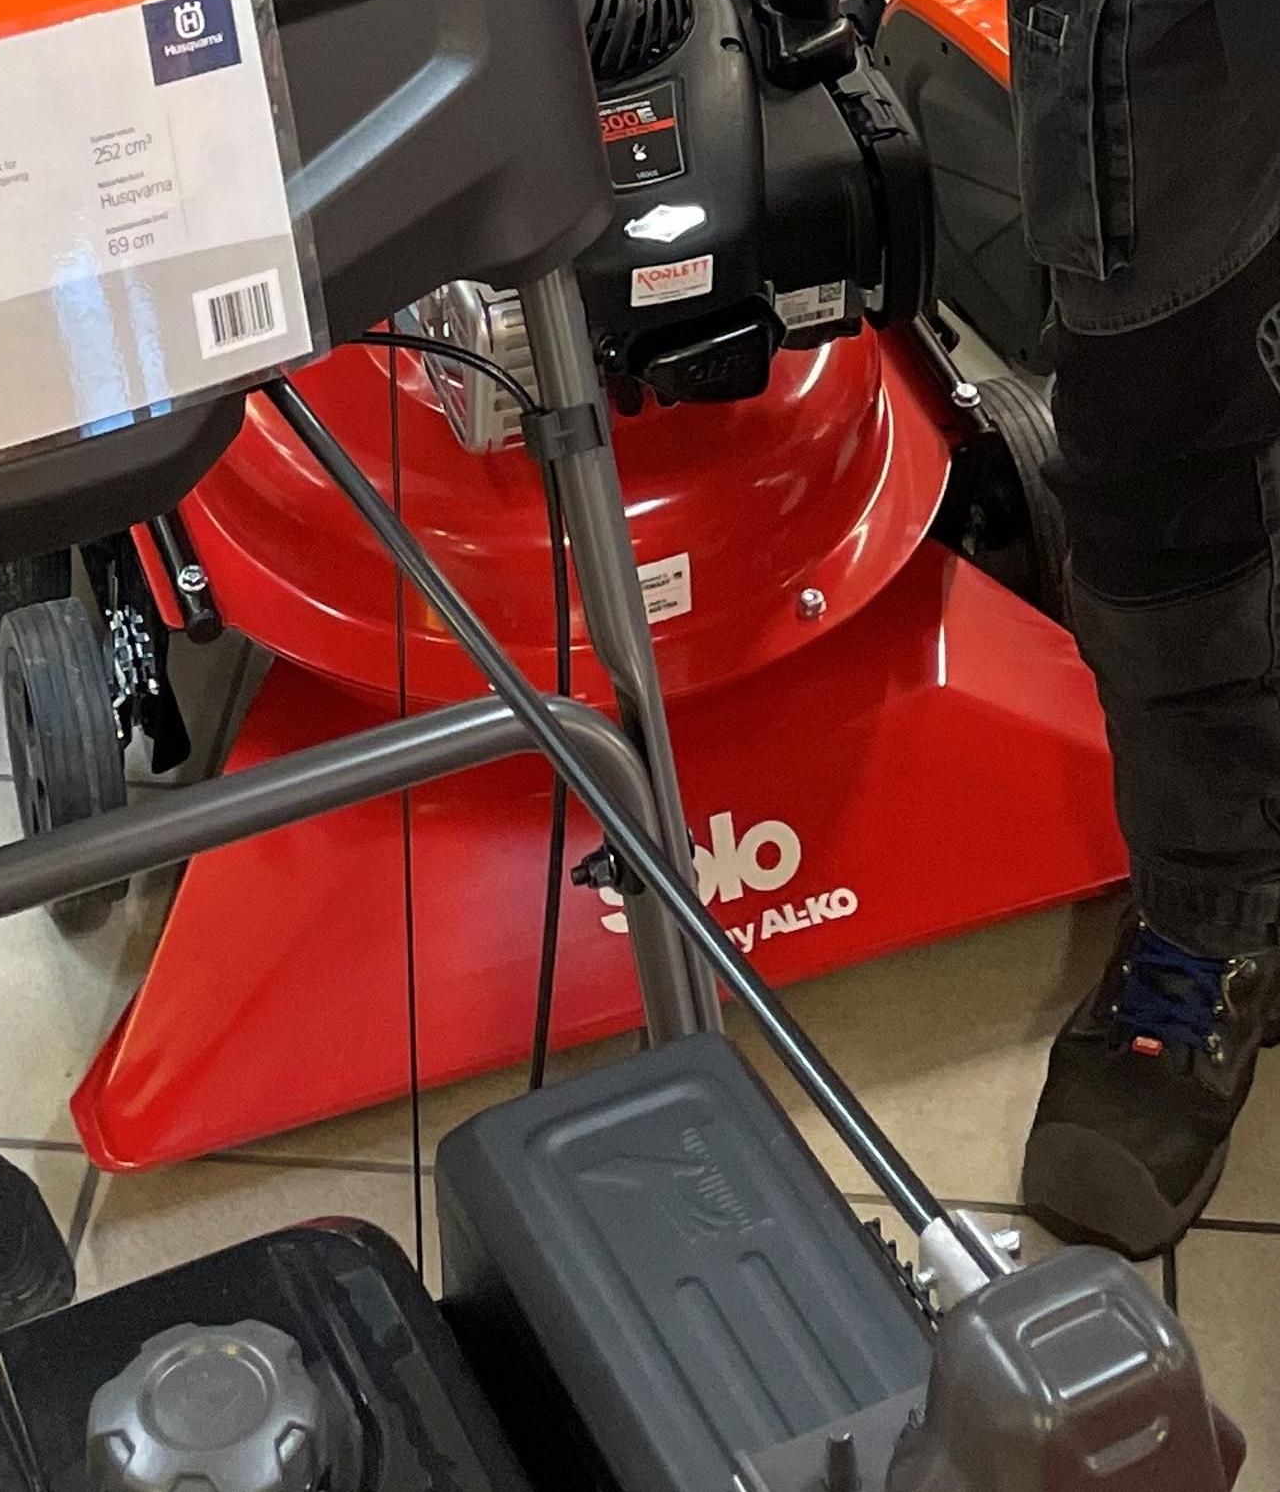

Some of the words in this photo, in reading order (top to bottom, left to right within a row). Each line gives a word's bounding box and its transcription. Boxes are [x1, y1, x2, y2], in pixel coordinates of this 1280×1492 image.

[164, 32, 223, 57] Husqvarna
[92, 142, 121, 166] 252
[100, 179, 173, 210] Husqvarna
[108, 236, 130, 256] 69
[132, 232, 155, 249] cm
[760, 887, 859, 940] AL-KO
